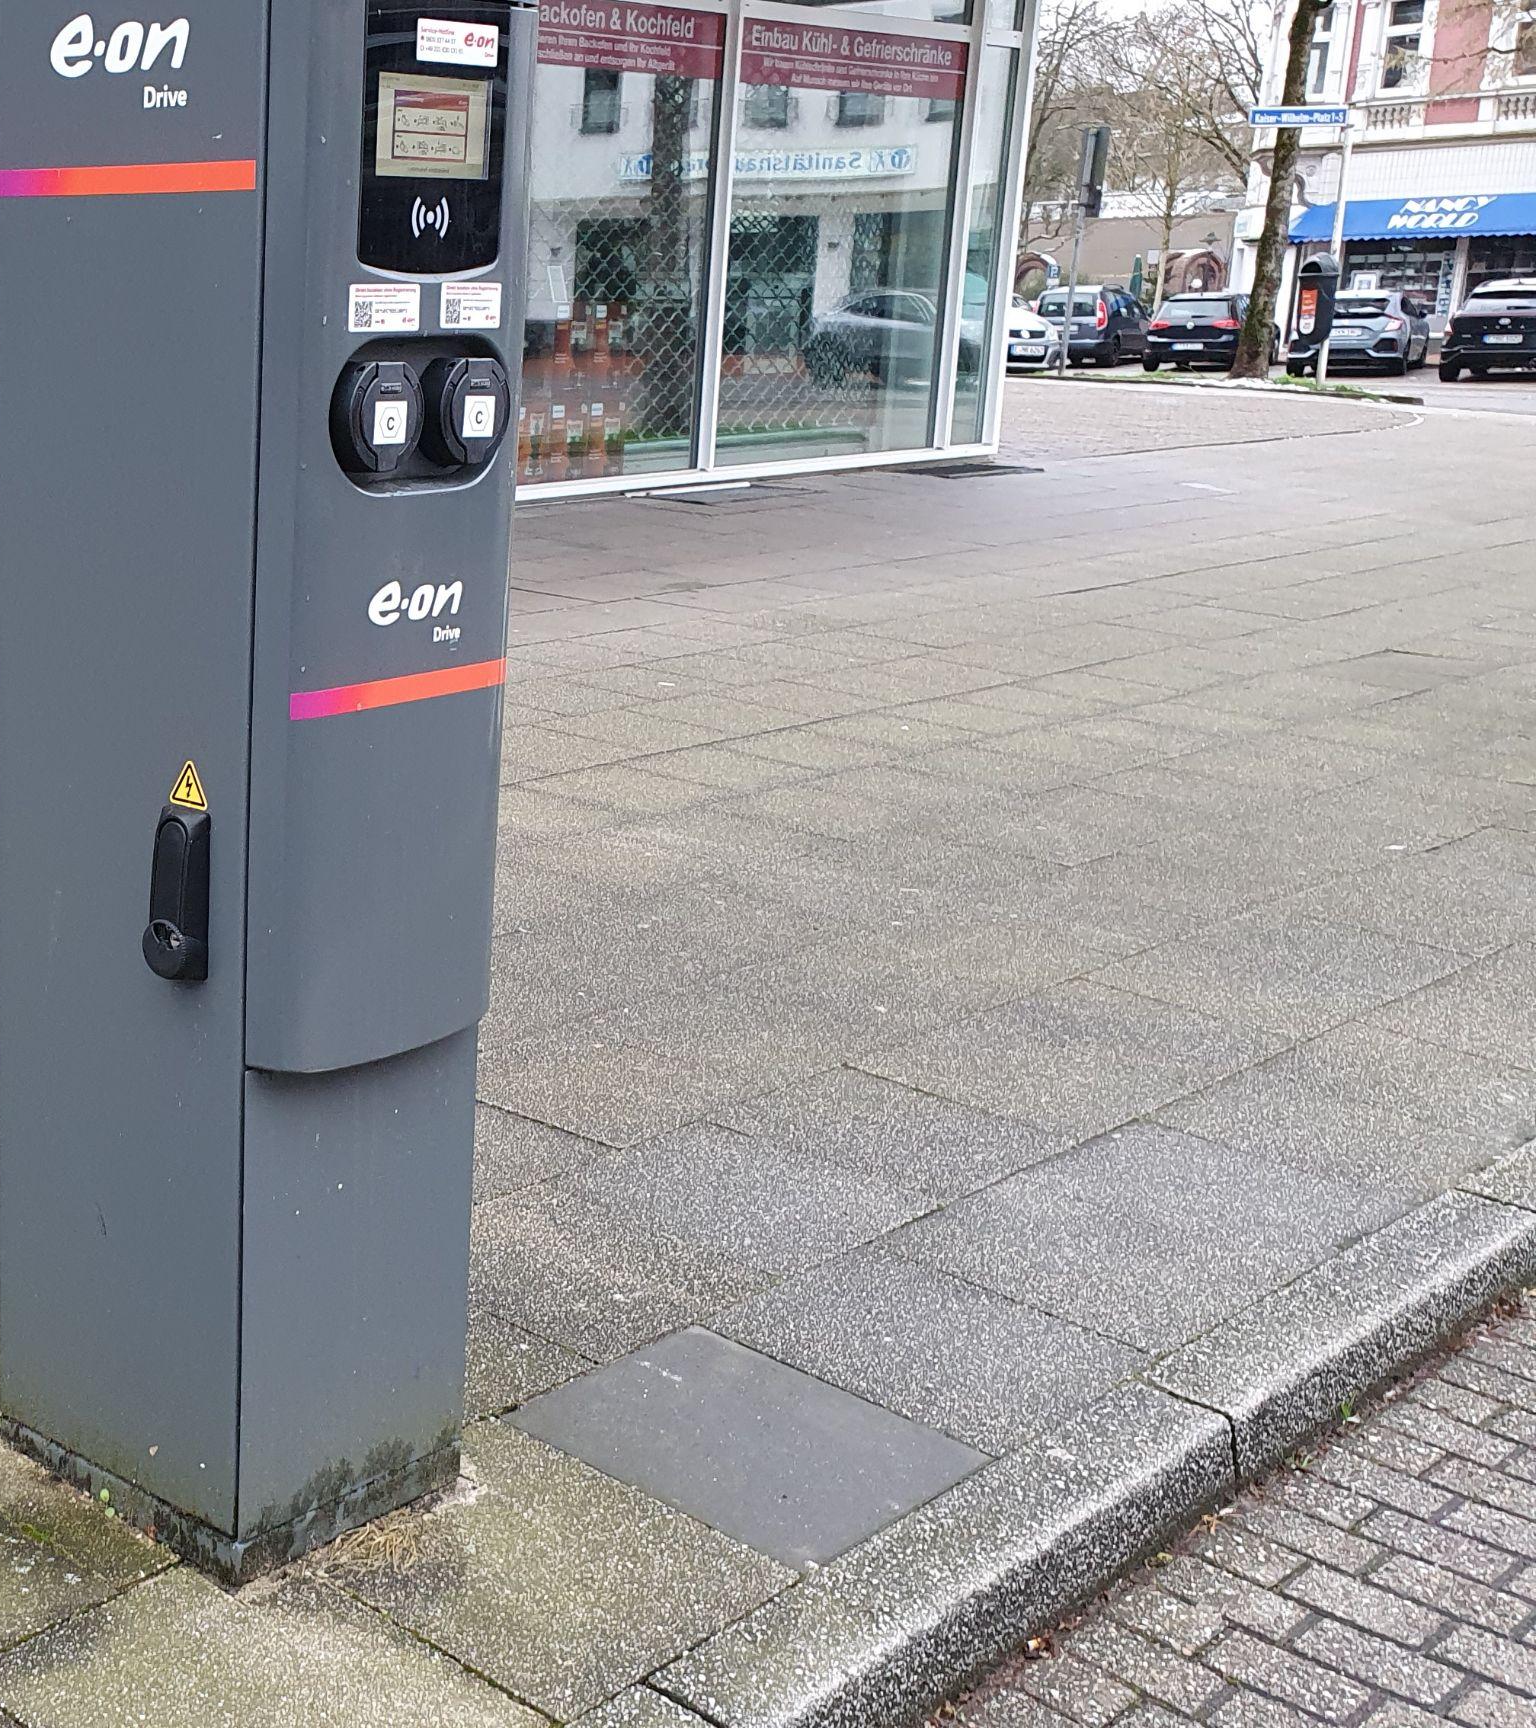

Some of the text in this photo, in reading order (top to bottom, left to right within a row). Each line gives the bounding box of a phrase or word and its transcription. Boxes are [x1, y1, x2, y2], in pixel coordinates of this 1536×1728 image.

[539, 1, 695, 39] ackofen & Kochfeld
[751, 24, 952, 66] Einbau Kühl- & Gefrierschränke
[143, 84, 188, 109] Drive
[1254, 111, 1331, 124] Kaiser-Wilhelm-Platz
[1387, 212, 1479, 230] WORLD
[386, 416, 395, 431] C
[475, 410, 483, 425] C
[432, 624, 461, 643] Drive
